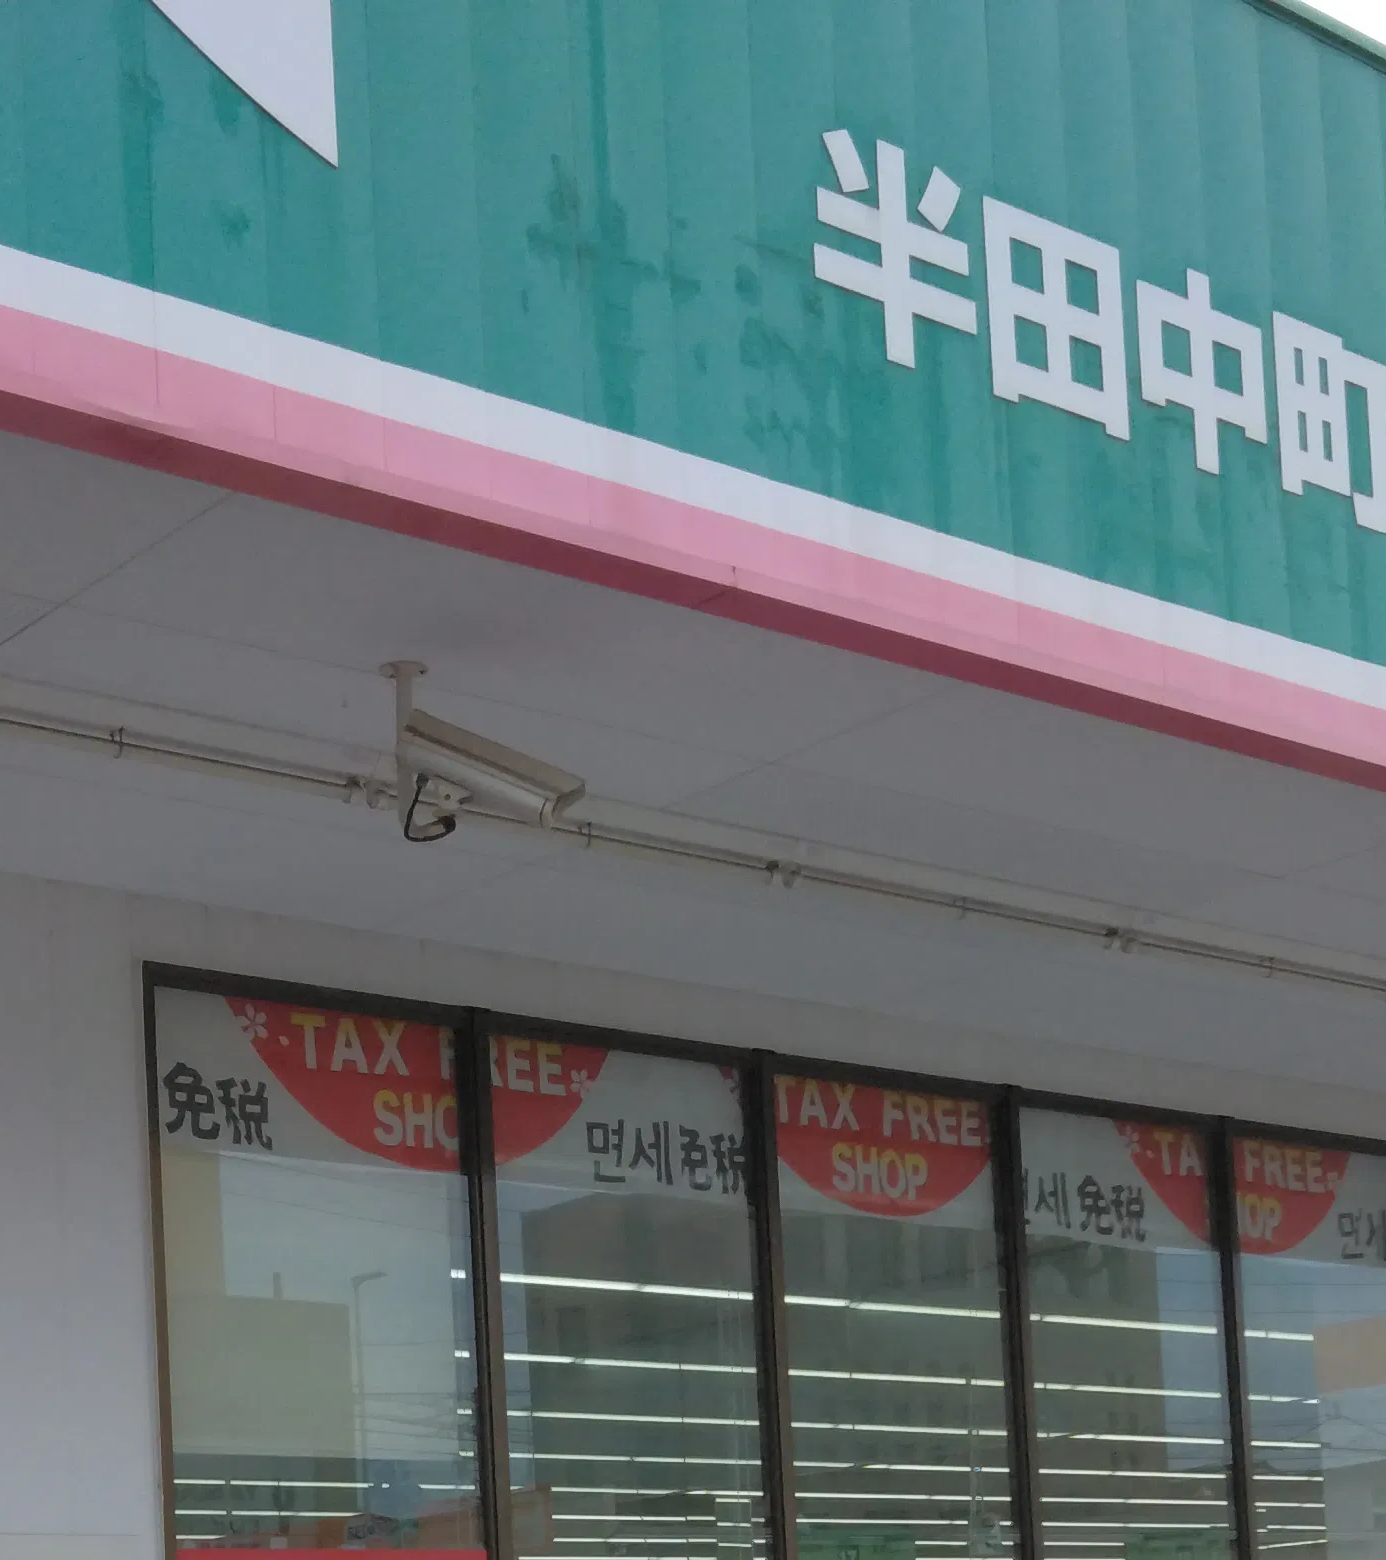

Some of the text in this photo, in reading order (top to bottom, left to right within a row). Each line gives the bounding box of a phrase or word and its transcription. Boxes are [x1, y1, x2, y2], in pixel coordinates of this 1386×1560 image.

[290, 1012, 410, 1077] TAX
[161, 1061, 273, 1152] 免税
[773, 1074, 984, 1147] TAX FREE
[832, 1141, 929, 1202] SHOP
[1242, 1138, 1326, 1194] FREE
